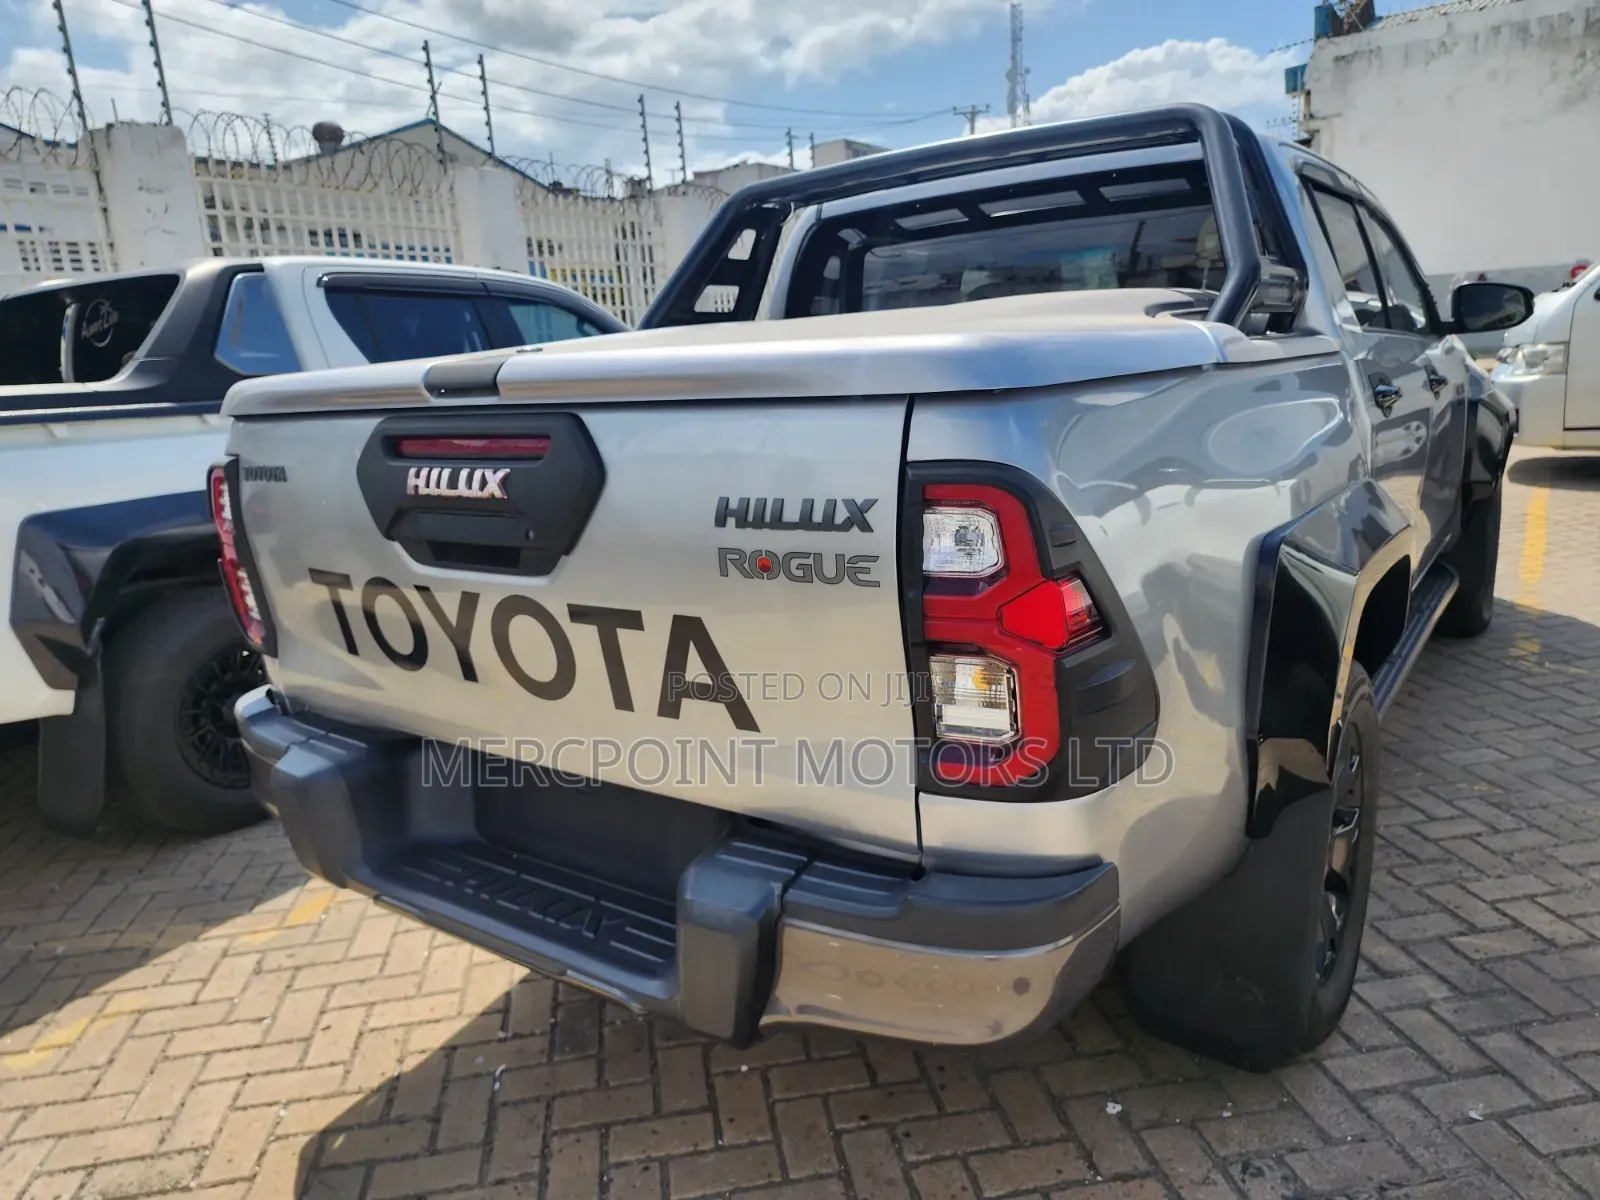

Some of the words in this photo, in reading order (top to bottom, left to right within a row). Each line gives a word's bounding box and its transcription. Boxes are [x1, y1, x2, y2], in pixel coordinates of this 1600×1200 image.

[407, 467, 511, 499] HILUX
[714, 496, 879, 533] HILUX
[717, 547, 881, 588] ROGUE
[308, 568, 762, 733] TOYOTA
